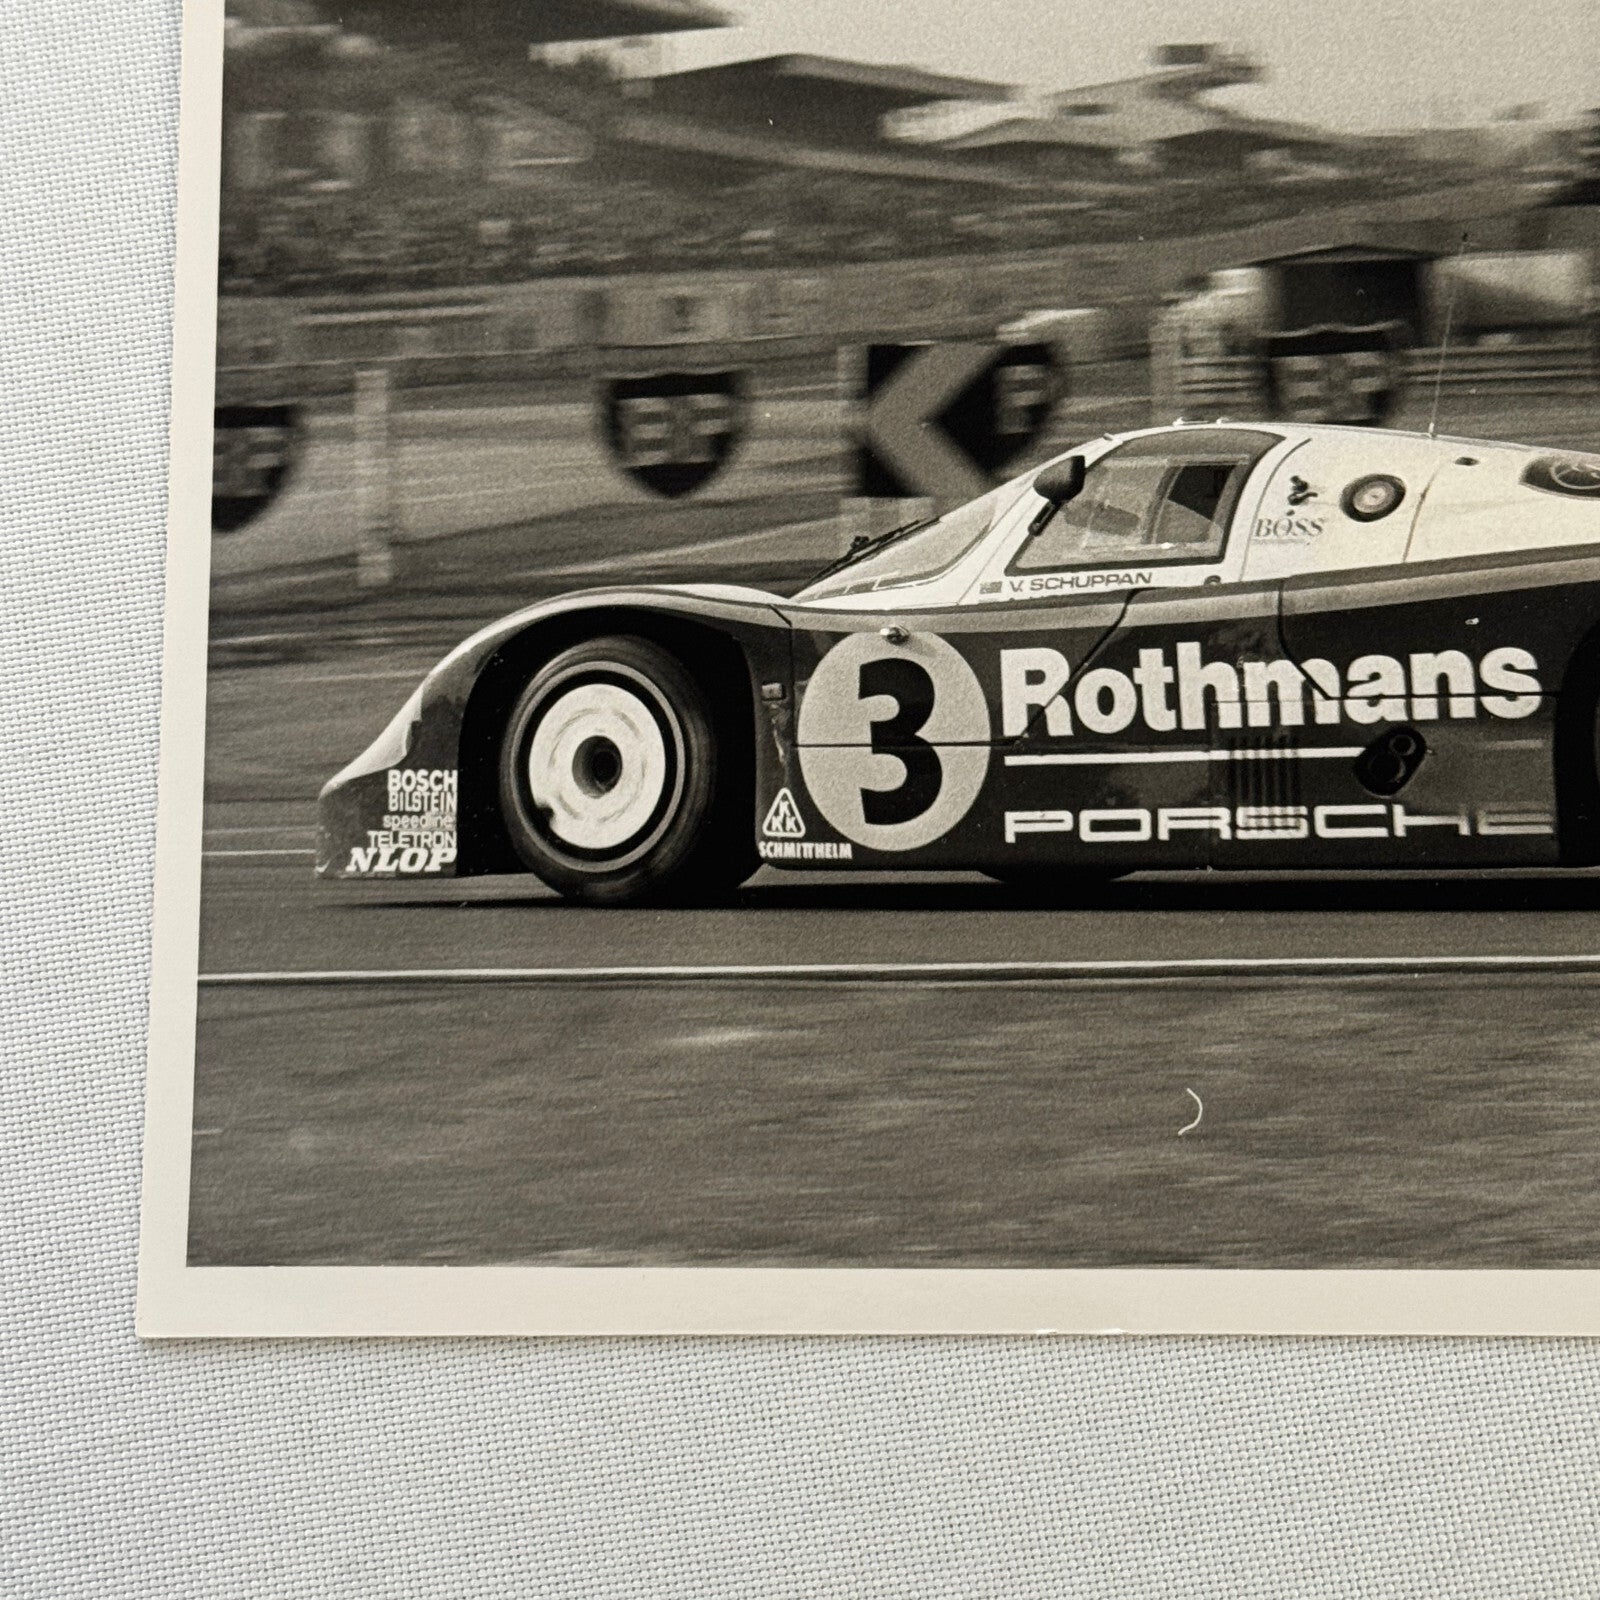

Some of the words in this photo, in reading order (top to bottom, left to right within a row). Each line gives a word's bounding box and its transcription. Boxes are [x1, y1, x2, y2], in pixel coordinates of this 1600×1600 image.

[1255, 517, 1327, 537] BOSS
[1009, 580, 1023, 593] V.
[1030, 572, 1153, 591] SCHUPPAN
[999, 641, 1543, 738] Rothmans
[858, 657, 943, 826] 3
[387, 769, 458, 792] BOSCH
[388, 791, 458, 812] BILSTEIN
[1004, 803, 1554, 844] PORSCHE
[367, 830, 458, 848] TELETRON
